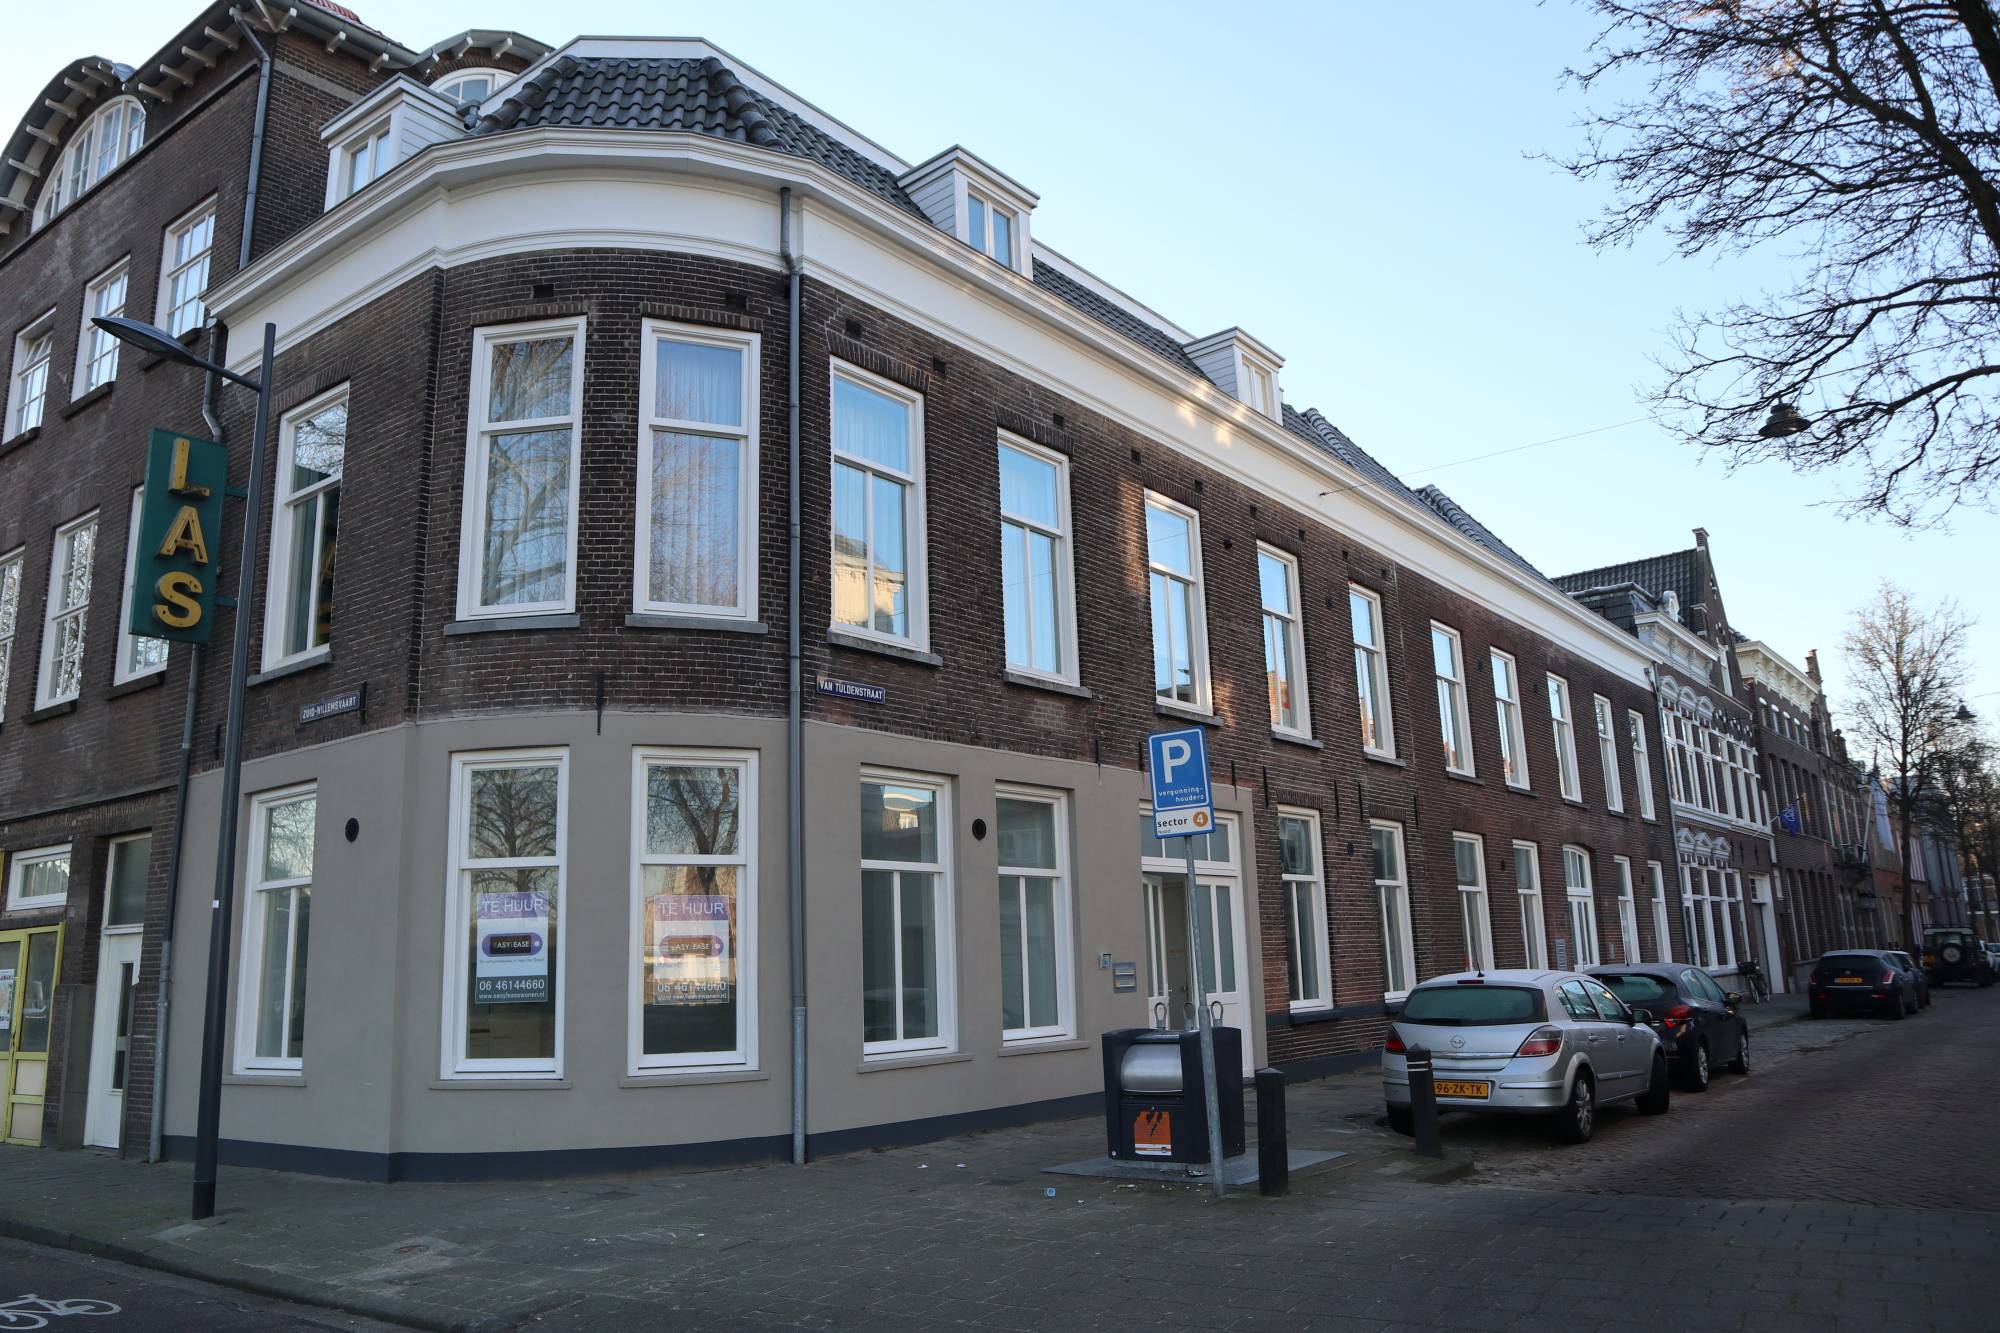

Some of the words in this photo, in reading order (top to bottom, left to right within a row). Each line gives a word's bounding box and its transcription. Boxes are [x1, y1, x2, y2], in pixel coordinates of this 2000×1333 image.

[152, 437, 210, 628] LAS
[820, 680, 833, 691] VAN
[836, 683, 882, 700] TULDENSTRAAT
[1161, 738, 1192, 784] P
[1159, 786, 1204, 797] vergunning-
[1175, 794, 1205, 803] houders
[1157, 817, 1188, 828] sector
[482, 900, 500, 913] TE
[504, 898, 544, 913] HUUR
[660, 902, 678, 915] TE
[682, 902, 724, 914] HUUR
[480, 981, 492, 991] 06
[495, 979, 545, 990] 46144660
[1436, 1083, 1482, 1095] 96-ZK-TK
